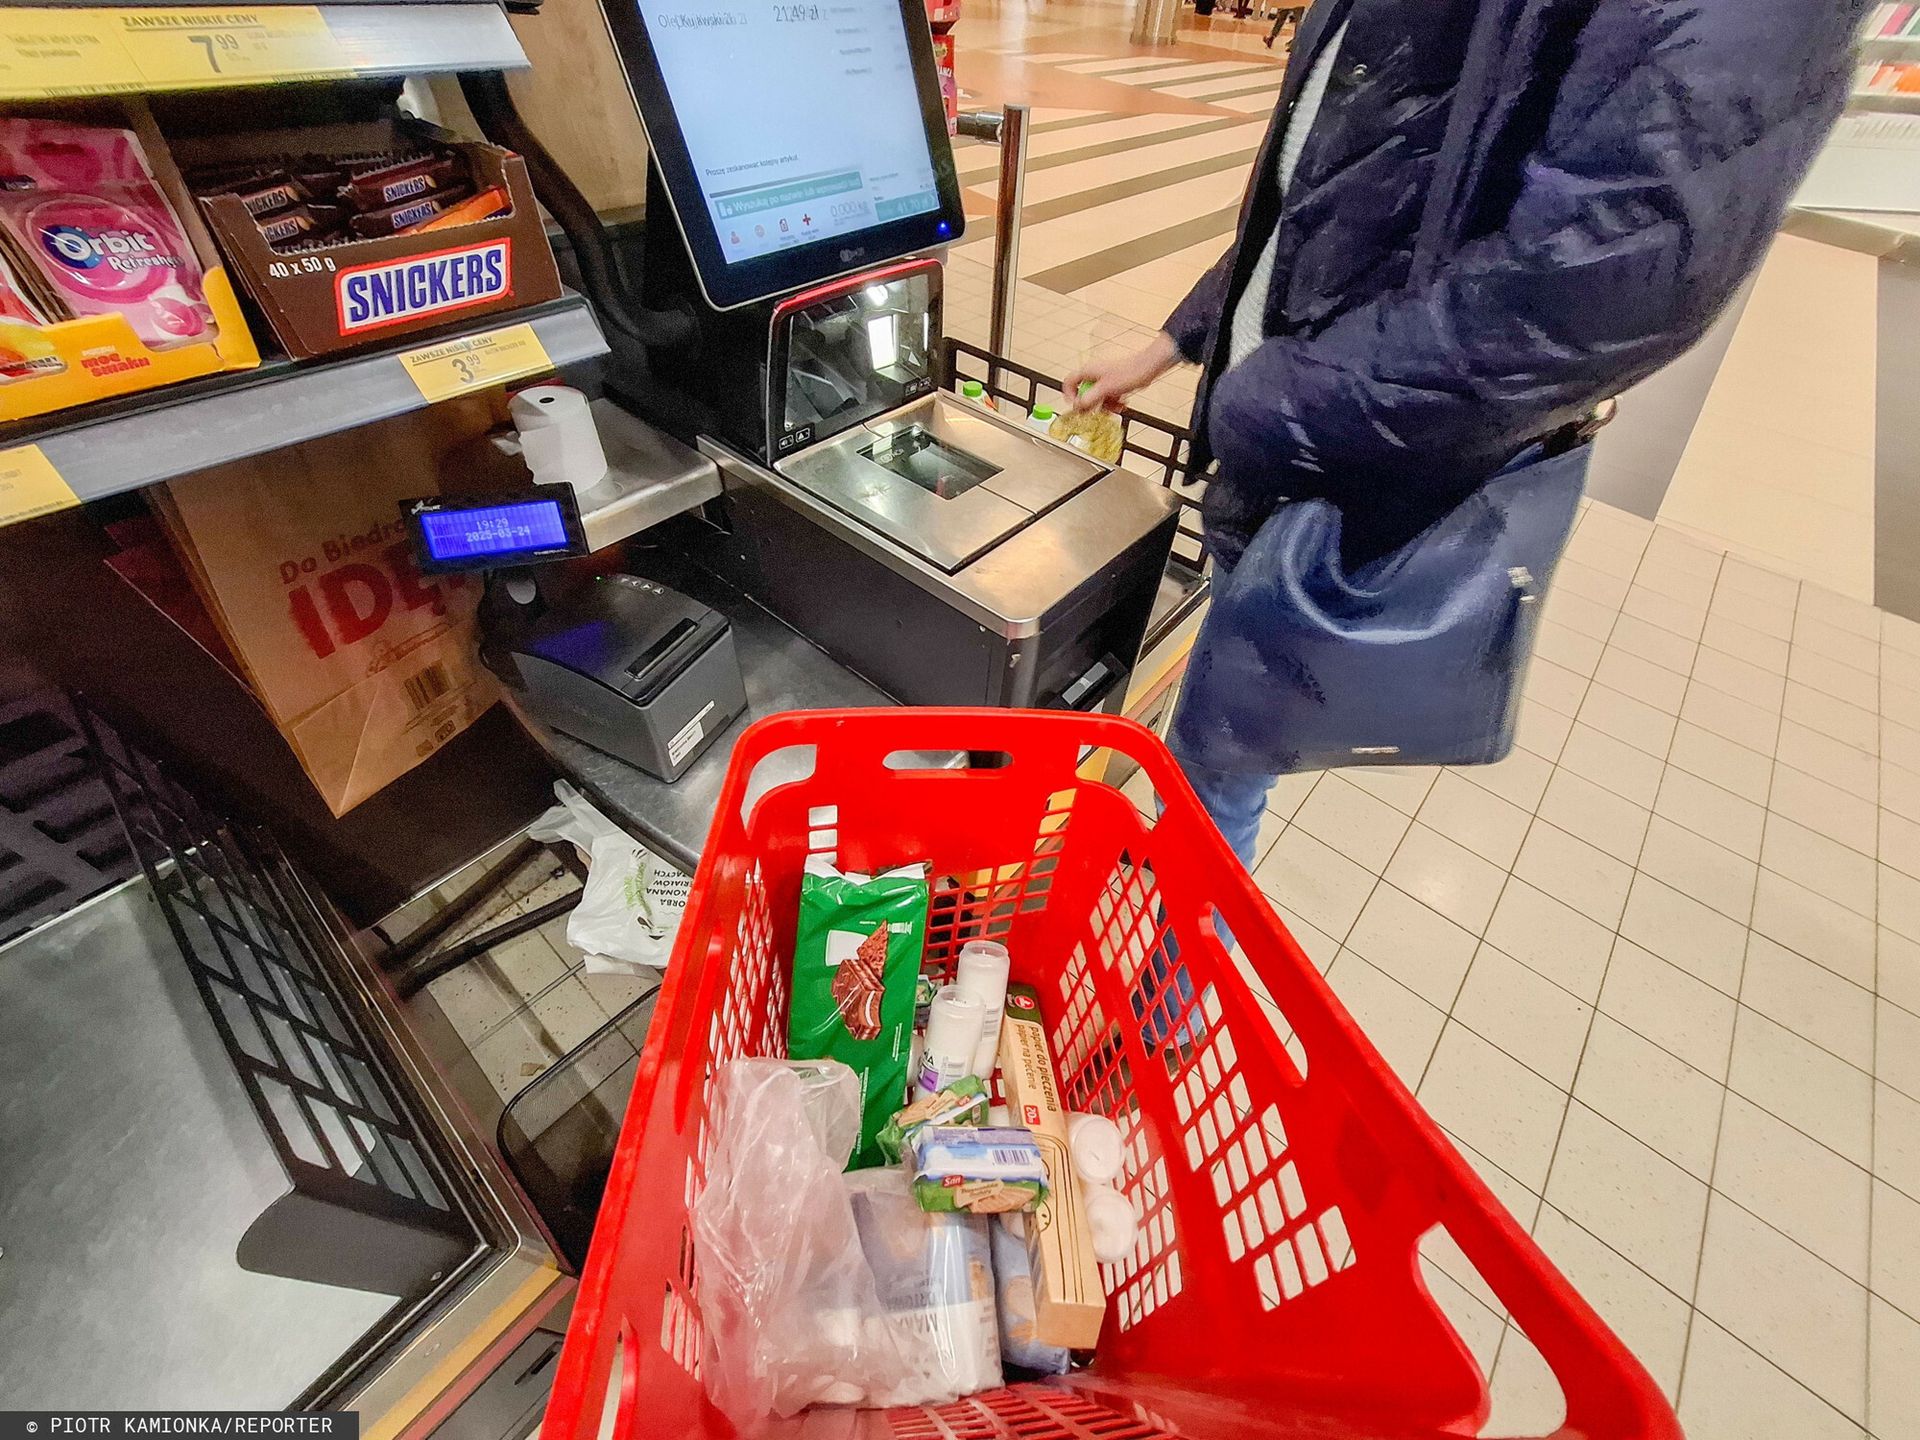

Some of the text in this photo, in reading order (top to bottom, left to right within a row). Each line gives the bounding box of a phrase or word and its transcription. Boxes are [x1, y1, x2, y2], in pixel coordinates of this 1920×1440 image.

[120, 14, 259, 27] ZAWSZE NISKIE CENY
[385, 177, 425, 202] SNICKERS
[394, 204, 431, 228] SNICKERS
[53, 229, 156, 261] Orbit
[269, 256, 336, 278] 40 x 50 g
[347, 250, 502, 323] SNICKERS
[82, 353, 121, 368] moc
[410, 348, 444, 364] ZAWSZE
[472, 336, 493, 347] CENY
[91, 357, 150, 377] smaku
[465, 525, 530, 543] 2025-03-24
[476, 518, 509, 531] 19:29
[279, 557, 318, 585] Do
[1015, 1023, 1030, 1048] papier
[1029, 1026, 1058, 1112] papier do pieczenia
[944, 1176, 961, 1187] San
